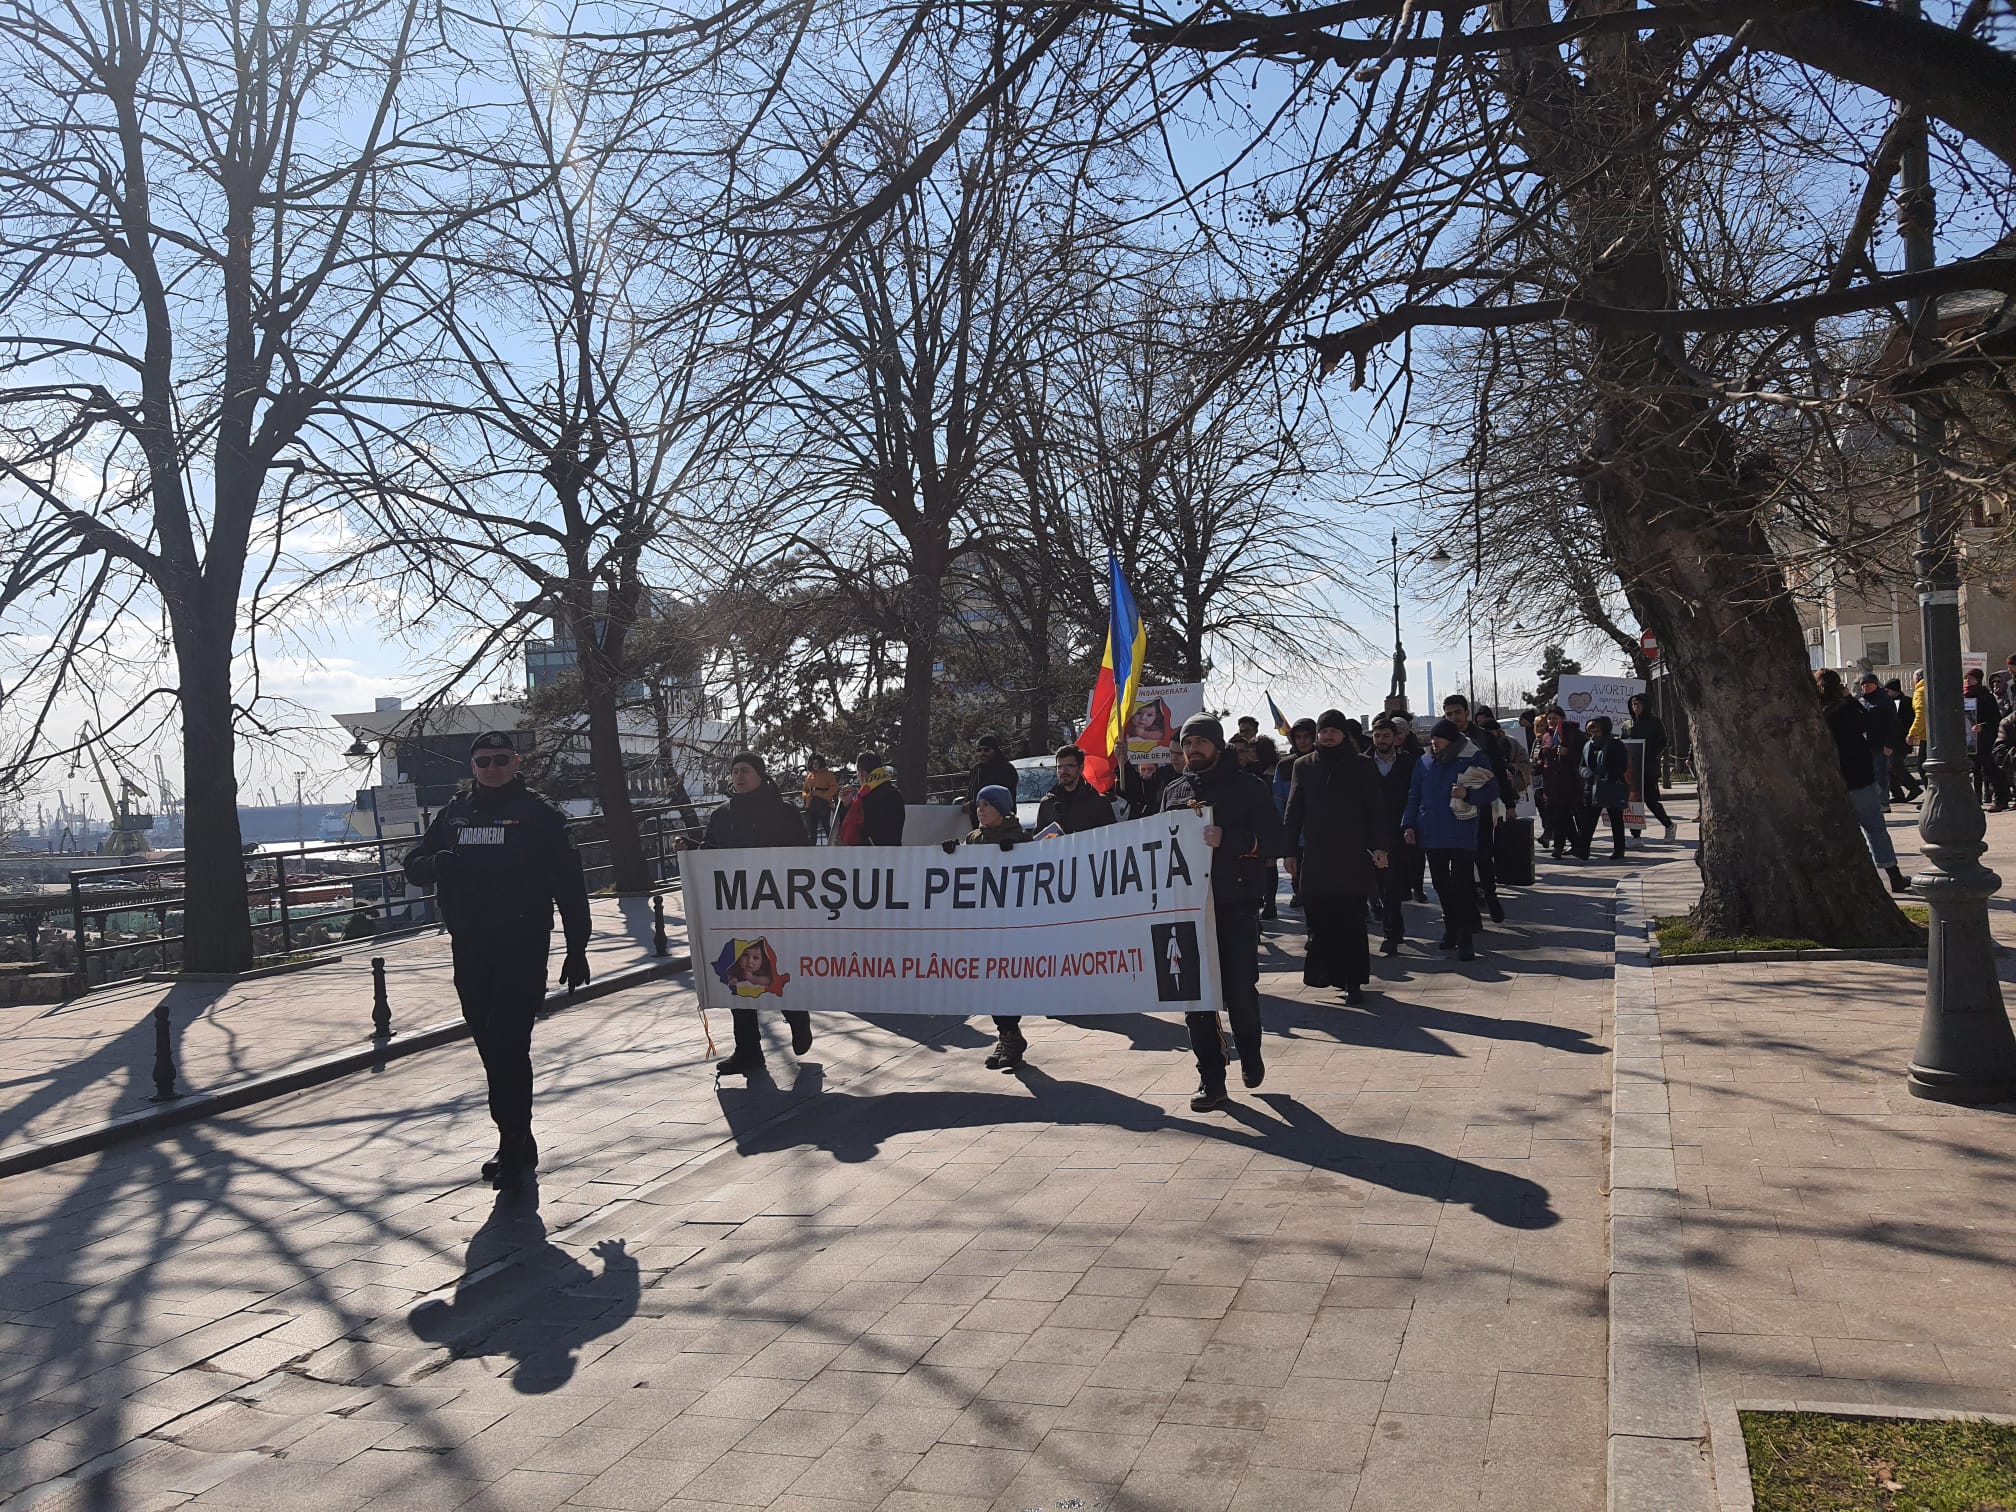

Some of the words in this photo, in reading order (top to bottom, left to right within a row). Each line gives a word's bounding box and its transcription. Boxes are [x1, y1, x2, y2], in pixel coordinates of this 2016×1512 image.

[924, 856, 1077, 910] PENTRU
[1088, 824, 1193, 911] VIAȚĂ
[799, 952, 897, 978] ROMÂNIA
[901, 952, 980, 980] PLÂNGE
[985, 954, 1057, 980] PRUNCII
[1060, 947, 1143, 982] AVORTAȚI
